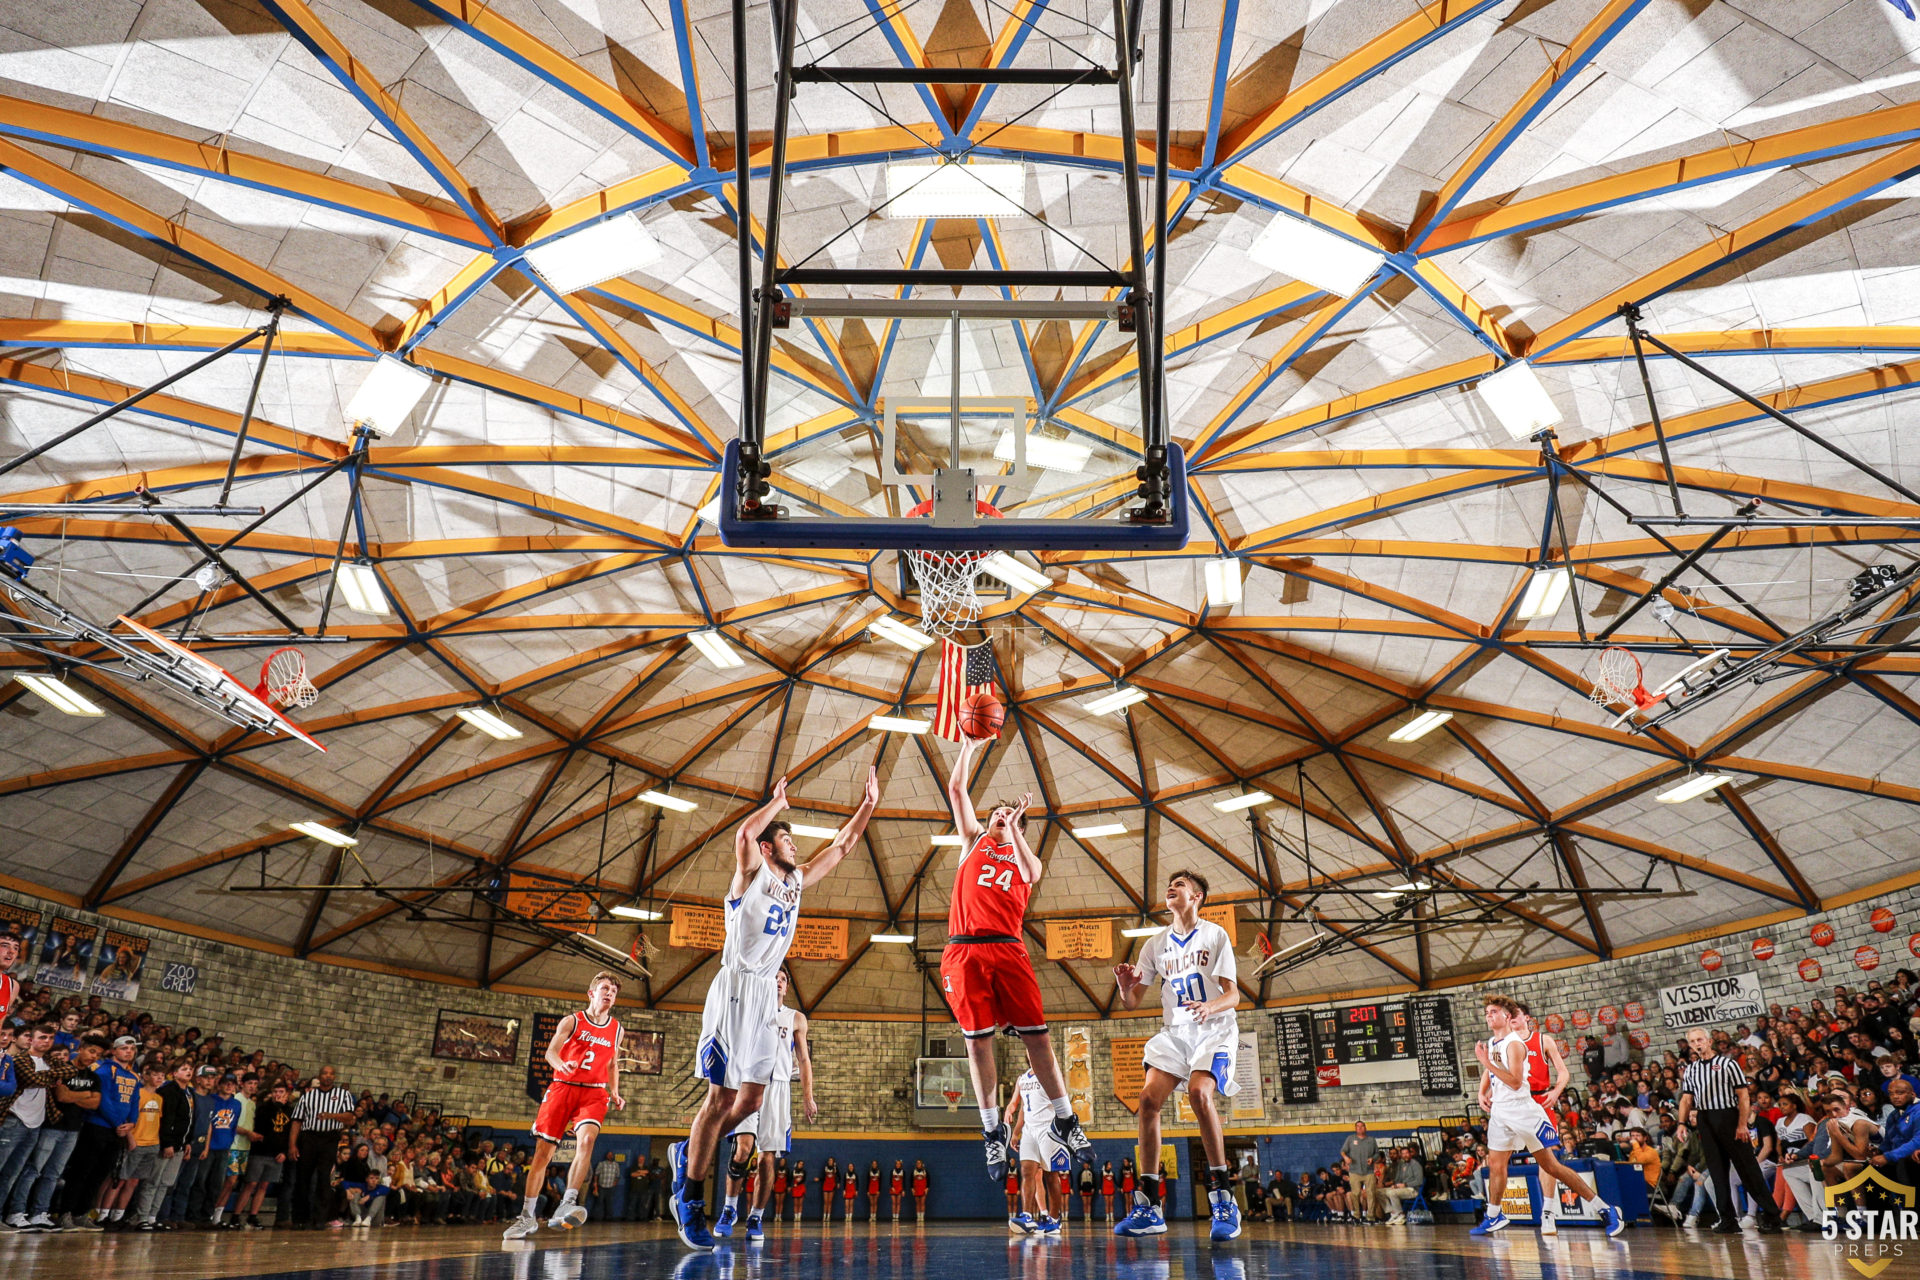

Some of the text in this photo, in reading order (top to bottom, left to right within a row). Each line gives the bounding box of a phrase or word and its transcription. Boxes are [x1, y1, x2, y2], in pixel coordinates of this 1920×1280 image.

[979, 846, 1018, 865] Kingsto
[977, 864, 1014, 892] 24
[168, 963, 195, 980] ZOO
[162, 976, 195, 993] CREW
[1171, 972, 1207, 1007] 20
[1666, 977, 1741, 1006] VISITOR
[1314, 1011, 1336, 1019] GUEST
[1350, 1006, 1377, 1023] 2:07
[1383, 1003, 1405, 1012] HOME
[1664, 1005, 1716, 1028] STUDENT
[1716, 1004, 1759, 1021] SECTION
[1324, 1019, 1336, 1034] 17
[1393, 1012, 1406, 1027] 16
[577, 1030, 612, 1048] Kingston
[1343, 1025, 1373, 1036] PERIOD 2
[1327, 1048, 1334, 1059] 8
[1357, 1044, 1377, 1056] 2 1
[1396, 1042, 1404, 1053] 2
[580, 1050, 595, 1070] 2
[1318, 1068, 1338, 1079] Coca-Cola
[1026, 1094, 1032, 1112] 1
